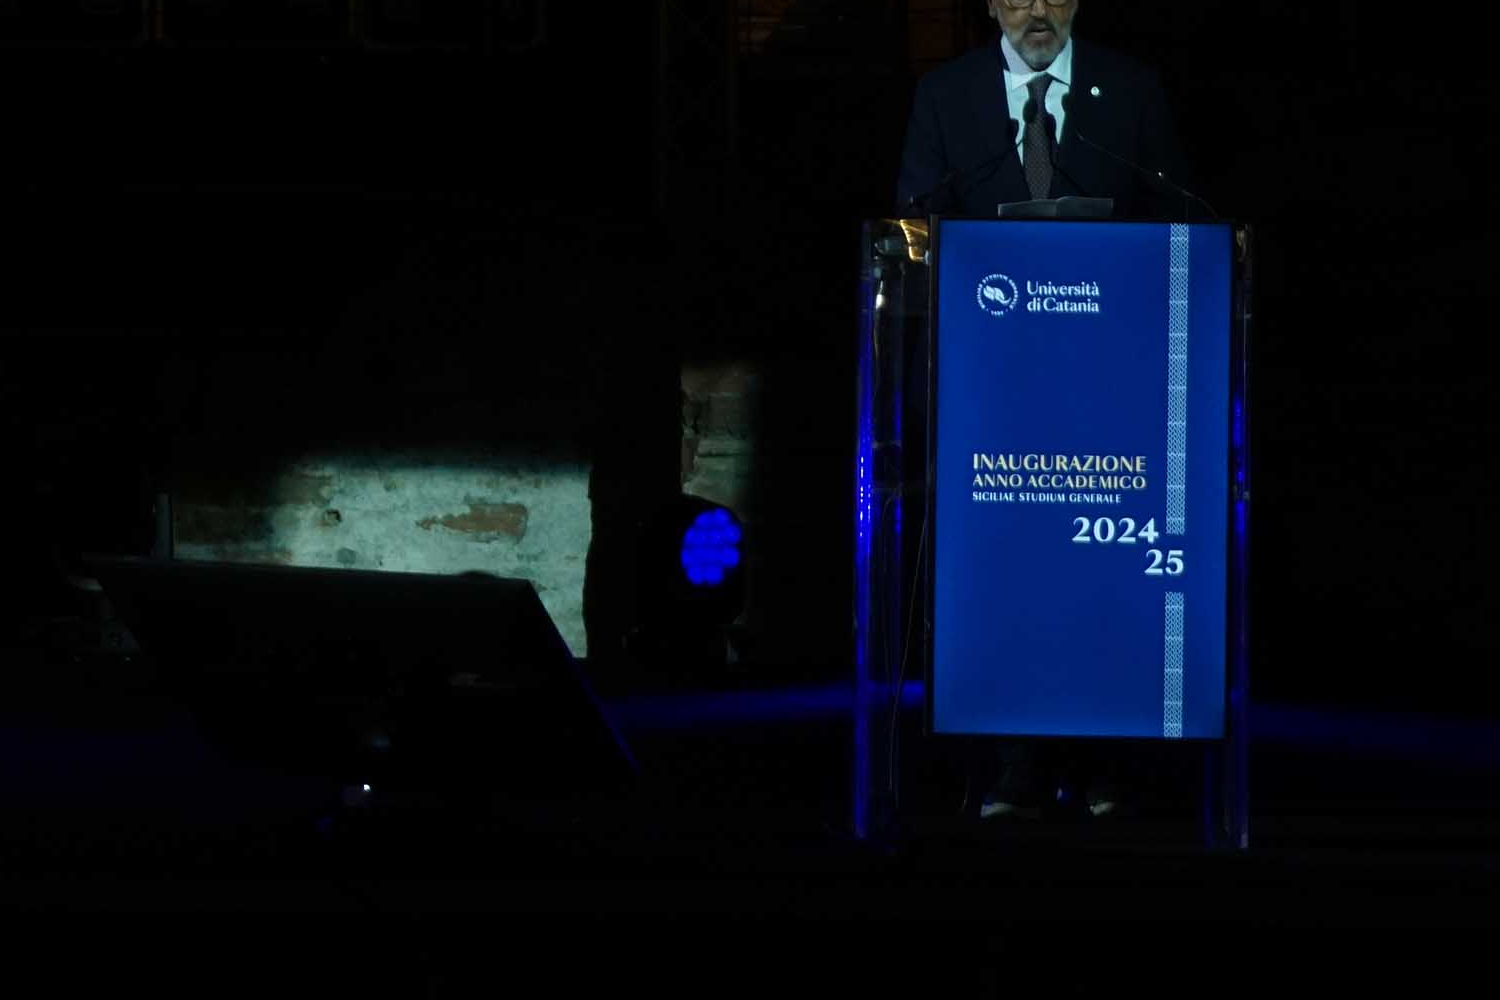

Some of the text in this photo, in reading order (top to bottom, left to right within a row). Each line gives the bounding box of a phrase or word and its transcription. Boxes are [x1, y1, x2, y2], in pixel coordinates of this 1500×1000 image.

[1026, 280, 1100, 297] Università
[1026, 297, 1100, 312] di Catania
[973, 453, 1147, 472] INAUGURAZIONE
[972, 473, 1147, 489] ANNO ACCADEMICO
[972, 491, 1122, 503] SICILIAE STUDIUM GENERALE
[1071, 517, 1159, 543] 2024
[1144, 549, 1184, 575] 25
